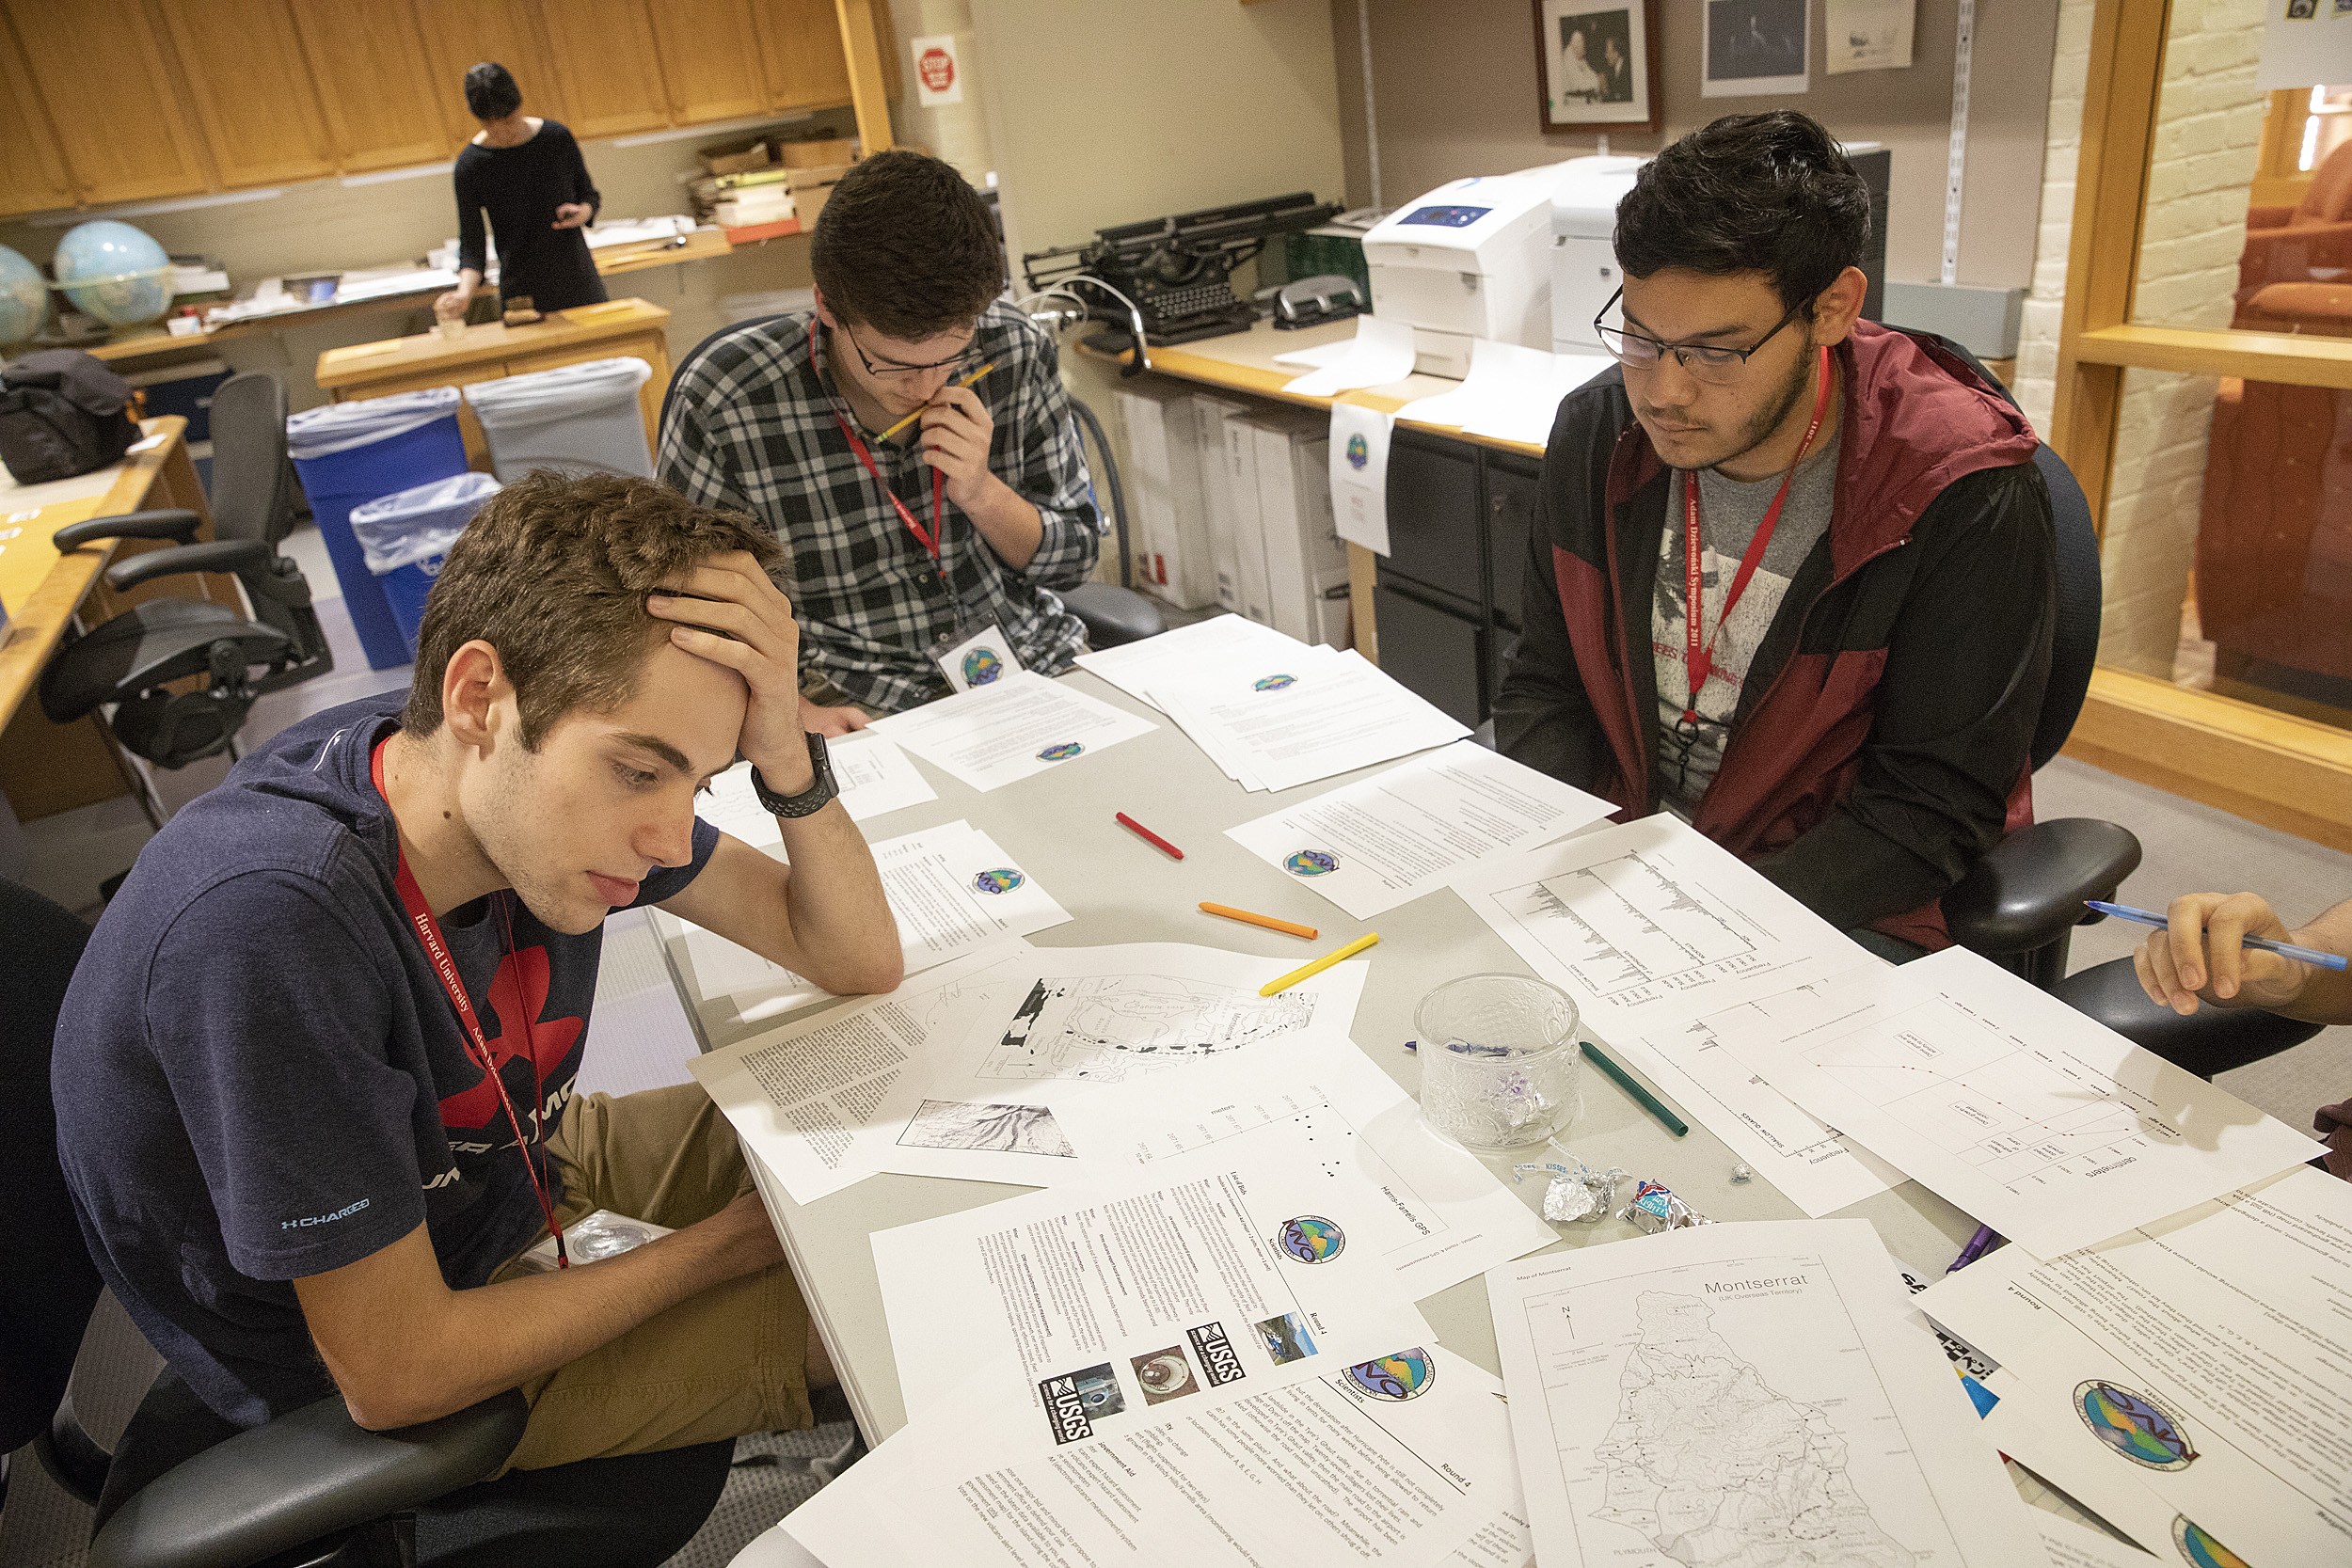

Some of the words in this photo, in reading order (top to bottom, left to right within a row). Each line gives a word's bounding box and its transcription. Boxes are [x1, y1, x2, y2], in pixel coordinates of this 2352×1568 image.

[1805, 419, 1819, 440] 2011
[1688, 576, 1700, 626] Symposium
[1689, 628, 1698, 646] 2011
[415, 912, 445, 960] Harvard
[439, 958, 469, 1013] University
[472, 1027, 489, 1057] Adam
[2090, 1082, 2106, 1094] weeks
[1212, 1104, 1235, 1115] meters
[2119, 1099, 2136, 1111] weeks
[1741, 1112, 1761, 1128] QUAKES
[2159, 1122, 2176, 1134] weeks
[1760, 1129, 1784, 1147] SHALLOW
[1809, 1148, 1849, 1165] Frequency
[2085, 1156, 2137, 1179] centimeters
[1230, 1171, 1238, 1180] List
[1237, 1184, 1246, 1195] Bids
[300, 1198, 370, 1227] CHARGED
[1381, 1186, 1416, 1222] Harris-Farrells
[1414, 1222, 1430, 1235] GPS
[1267, 1238, 1281, 1259] Scientists
[2154, 1239, 2172, 1253] EDM
[2171, 1248, 2198, 1268] require
[1538, 1266, 1572, 1276] Montserrat
[2195, 1264, 2219, 1281] would
[1705, 1274, 1810, 1294] Montserrat
[2217, 1274, 2260, 1305] (monitoring
[1718, 1295, 1733, 1304] (UK
[1734, 1291, 1770, 1301] Overseas
[1770, 1288, 1803, 1299] Territory)
[2016, 1289, 2042, 1311] Round
[1039, 1308, 1052, 1337] measurement)
[1310, 1312, 1324, 1330] Round
[1189, 1330, 1201, 1346] science
[1199, 1354, 1215, 1373] changing
[1209, 1372, 1220, 1385] world
[1203, 1338, 1244, 1382] USGS
[1335, 1379, 1364, 1403] Scientists
[1041, 1383, 1052, 1399] science
[1048, 1409, 1062, 1429] changing
[1056, 1428, 1066, 1442] world
[1052, 1393, 1092, 1441] USGS
[2097, 1381, 2201, 1462] MVO
[1295, 1386, 1305, 1395] but
[1304, 1394, 1313, 1402] the
[1313, 1402, 1340, 1424] devastation
[1340, 1424, 1353, 1434] after
[1352, 1434, 1377, 1455] Hurricane
[1376, 1454, 1389, 1465] Pete
[1394, 1469, 1406, 1478] still
[1404, 1478, 1415, 1487] not
[1414, 1486, 1444, 1511] completely
[1267, 1395, 1288, 1413] landslide
[1289, 1418, 1304, 1427] the
[1304, 1426, 1319, 1440] Tyre's
[1319, 1440, 1336, 1454] Ghaut
[1353, 1469, 1364, 1479] due
[1372, 1485, 1398, 1507] torrential
[1397, 1507, 1409, 1517] rain
[1410, 1518, 1422, 1528] and
[1441, 1463, 1465, 1482] Round
[1231, 1421, 1240, 1429] the
[1240, 1429, 1253, 1441] same
[1252, 1441, 1271, 1455] place?
[1271, 1458, 1284, 1468] And
[1283, 1468, 1296, 1480] what
[1296, 1481, 1312, 1495] about
[1311, 1494, 1322, 1504] the
[1321, 1503, 1339, 1517] road?
[1371, 1547, 1382, 1557] the
